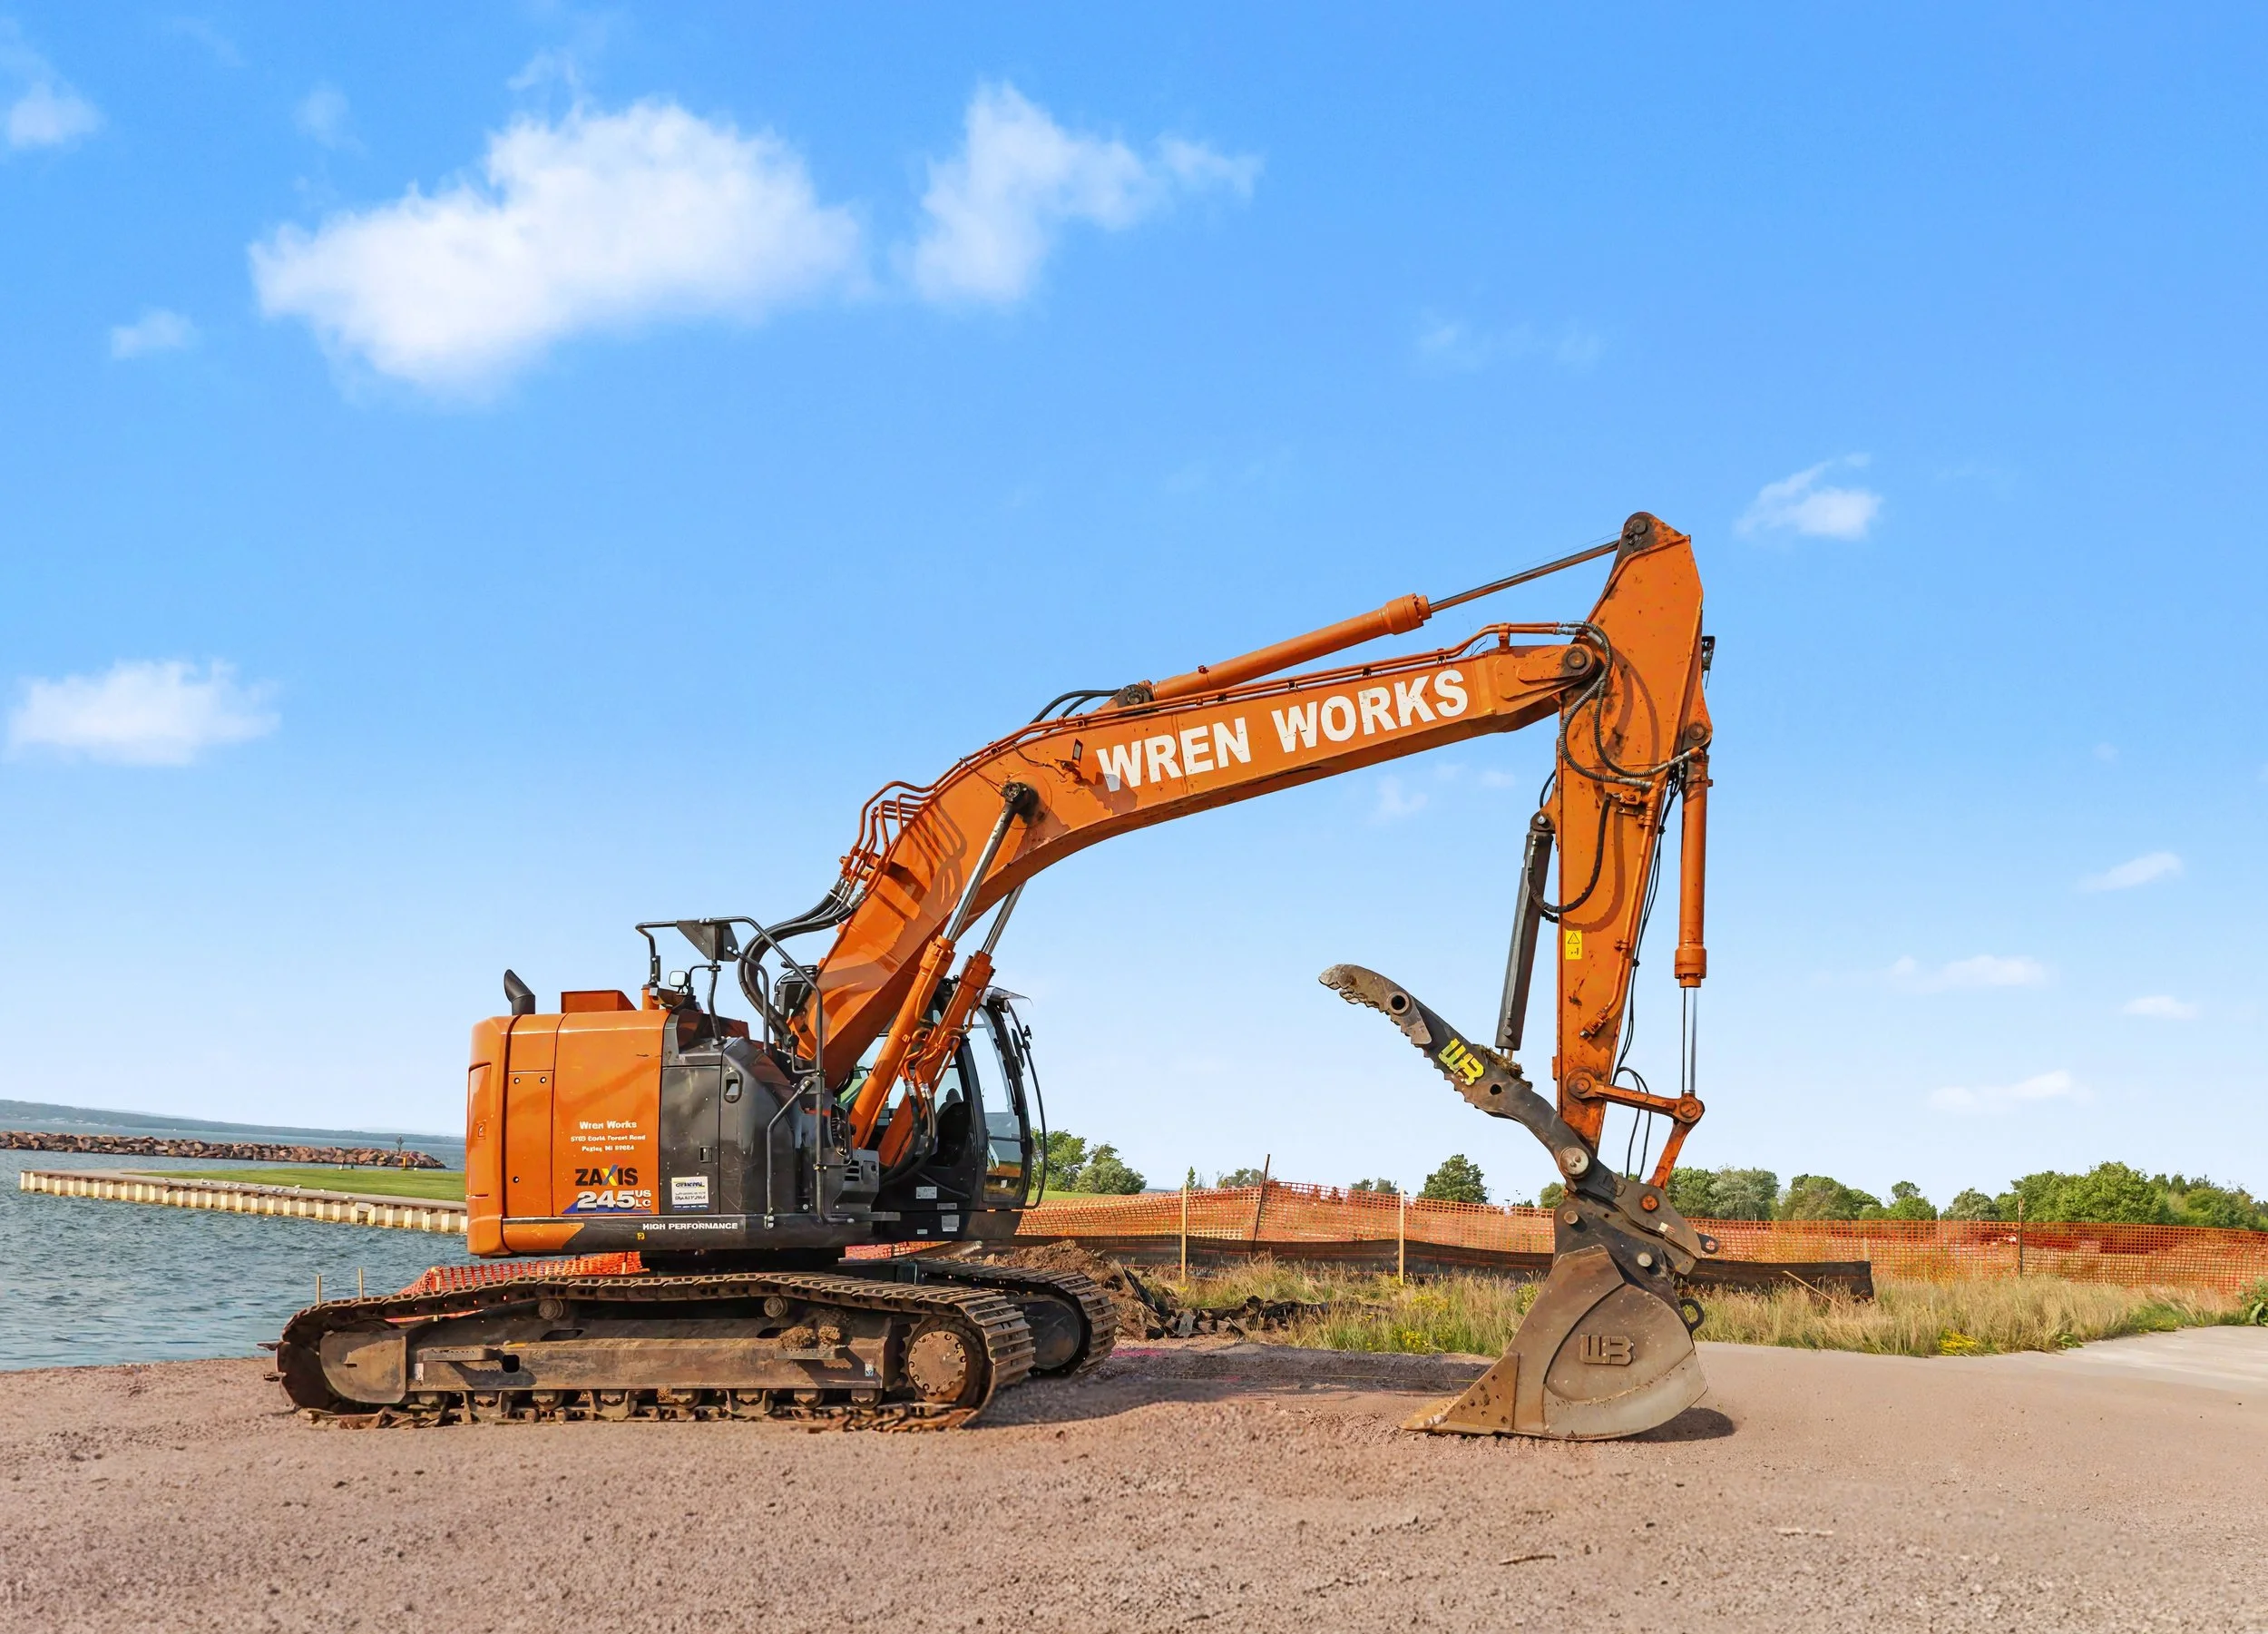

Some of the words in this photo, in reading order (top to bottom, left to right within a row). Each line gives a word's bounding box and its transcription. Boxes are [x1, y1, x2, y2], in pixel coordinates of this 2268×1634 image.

[1096, 717, 1251, 792] WREN
[1271, 670, 1469, 753] WORKS
[580, 1120, 604, 1130] Wren
[607, 1120, 637, 1129] Works
[575, 1164, 639, 1187] ZAXIS
[635, 1189, 651, 1198] US
[577, 1189, 635, 1209] 245
[635, 1199, 651, 1208] LC
[642, 1223, 666, 1231] HIGH
[669, 1222, 738, 1230] PERFORMANCE
